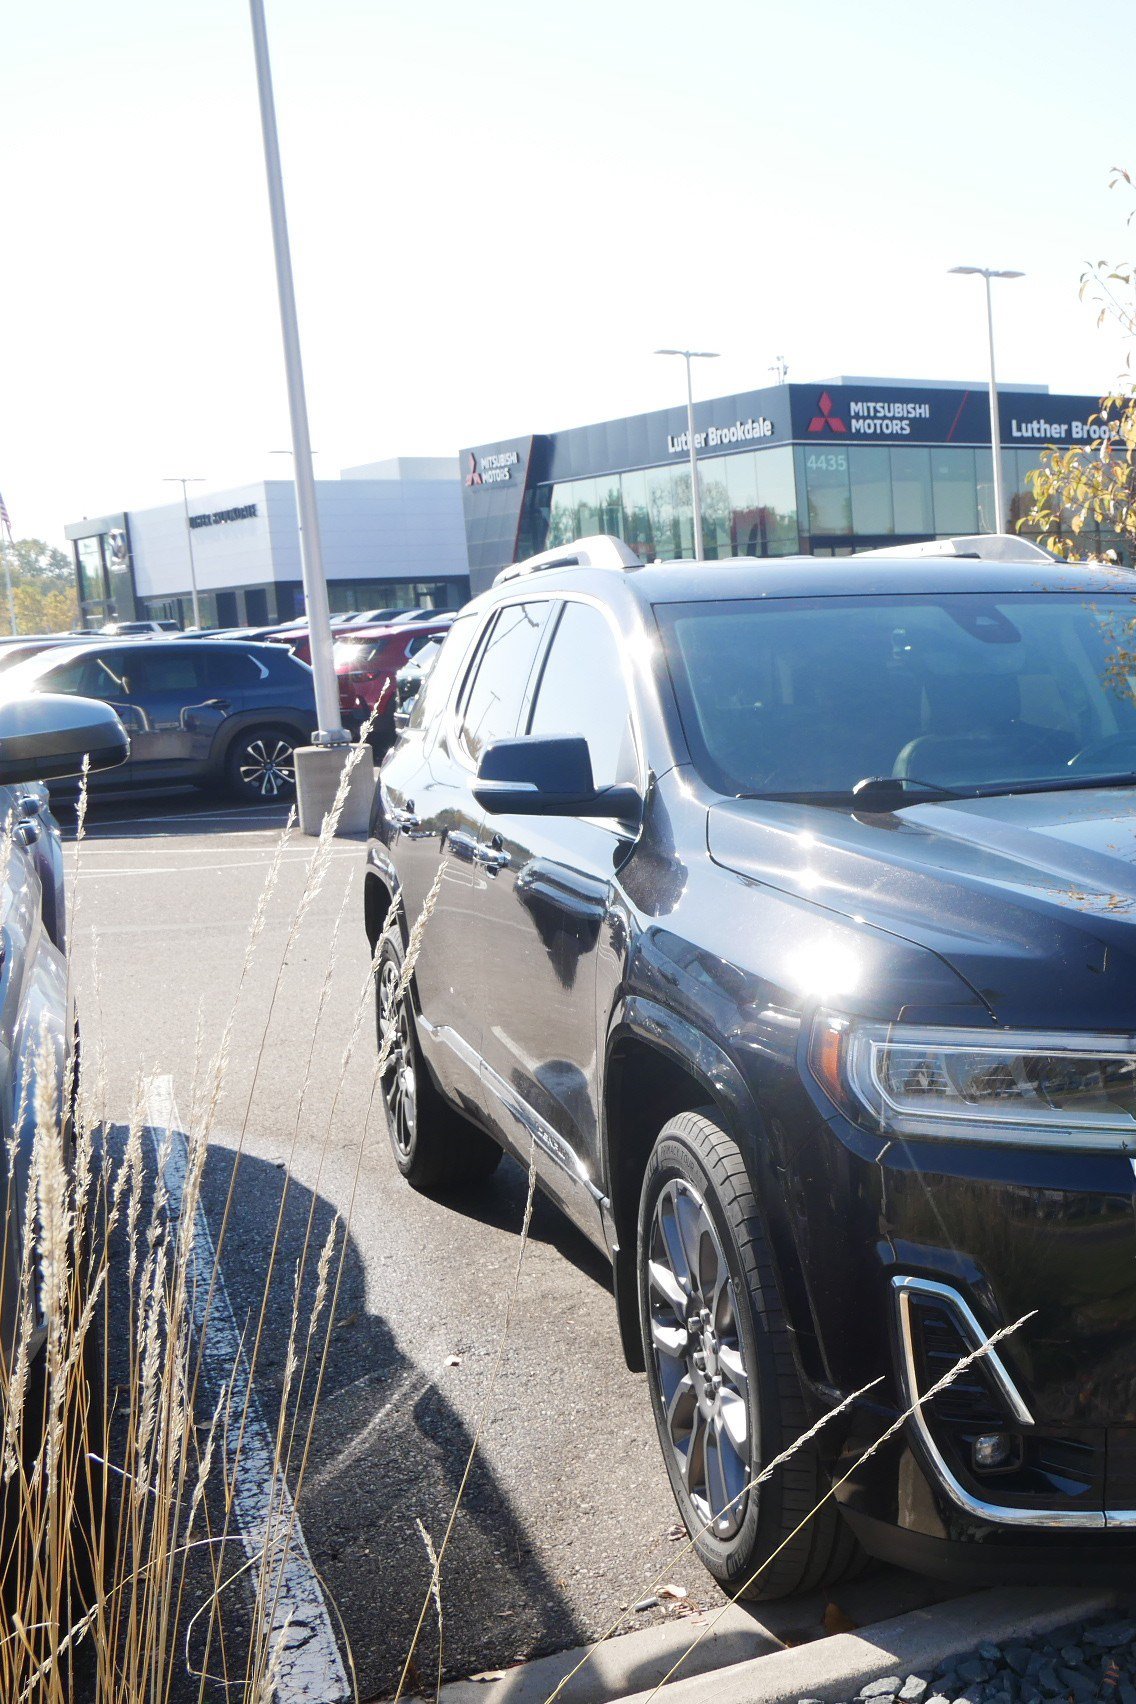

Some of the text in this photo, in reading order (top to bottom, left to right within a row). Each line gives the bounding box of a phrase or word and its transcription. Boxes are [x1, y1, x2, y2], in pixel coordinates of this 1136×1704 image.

[850, 401, 929, 418] MITSUBISHI
[708, 417, 772, 446] Brookdale
[851, 420, 910, 434] MOTORS
[1011, 419, 1068, 438] Luther
[481, 452, 518, 472] MITSUBISHI
[806, 455, 846, 471] 4435
[482, 467, 511, 484] MOTORS
